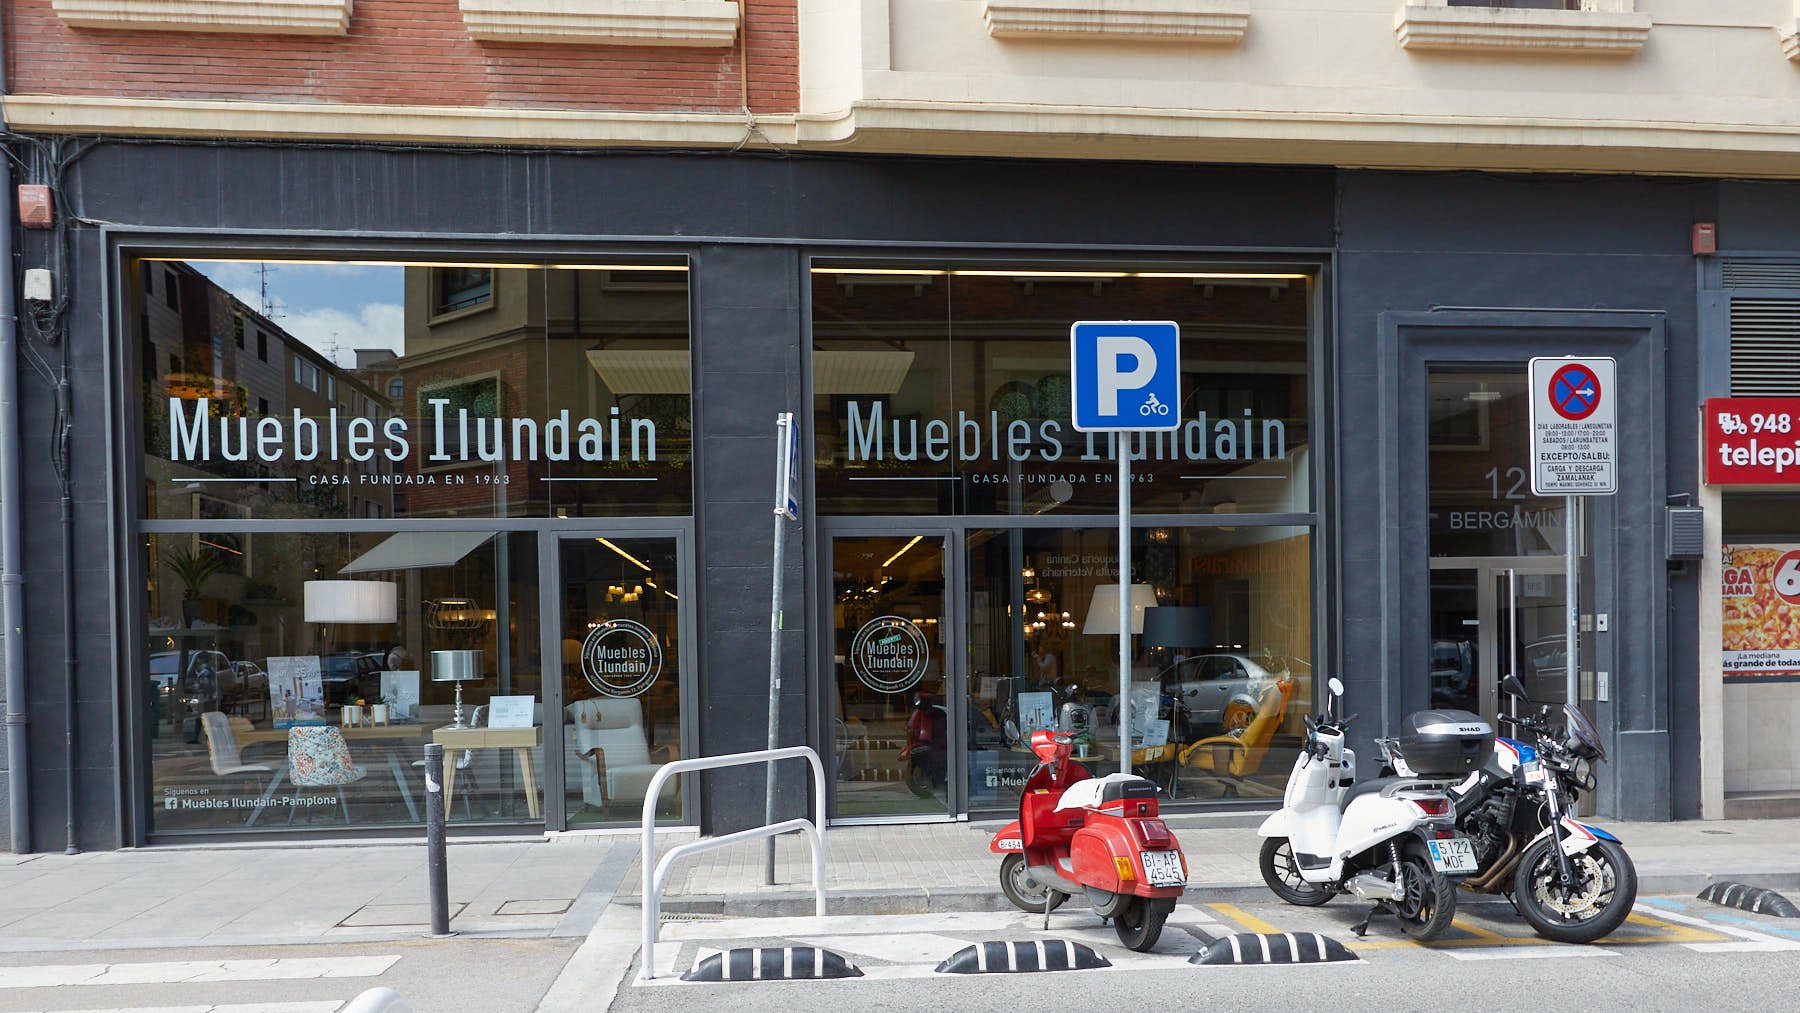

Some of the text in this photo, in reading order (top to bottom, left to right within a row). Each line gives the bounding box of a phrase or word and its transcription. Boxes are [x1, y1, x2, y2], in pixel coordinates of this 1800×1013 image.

[1097, 336, 1157, 417] P
[169, 397, 657, 462] Muebles Ilundain
[1750, 413, 1791, 433] 948
[847, 400, 1063, 462] Muebles
[1718, 438, 1800, 473] telepi
[309, 474, 510, 485] CASA FUNDADA EN 1963
[972, 473, 1154, 484] CASA FUNDADA EN 963
[1485, 466, 1526, 500] 12
[1557, 474, 1595, 482] ZAMALANAK
[597, 645, 646, 659] Muebles
[867, 641, 913, 655] Muebles
[597, 659, 646, 673] Ilundain
[867, 655, 913, 669] Ilundain
[1733, 660, 1764, 669] grande
[1765, 659, 1777, 667] de
[1778, 659, 1800, 667] todas
[1001, 776, 1029, 787] Mueb
[199, 787, 209, 795] en
[182, 795, 337, 809] Muebles Ilundain-Pamplona
[1438, 841, 1471, 855] 5122
[1442, 855, 1464, 869] MDF
[1151, 866, 1180, 881] 4545
